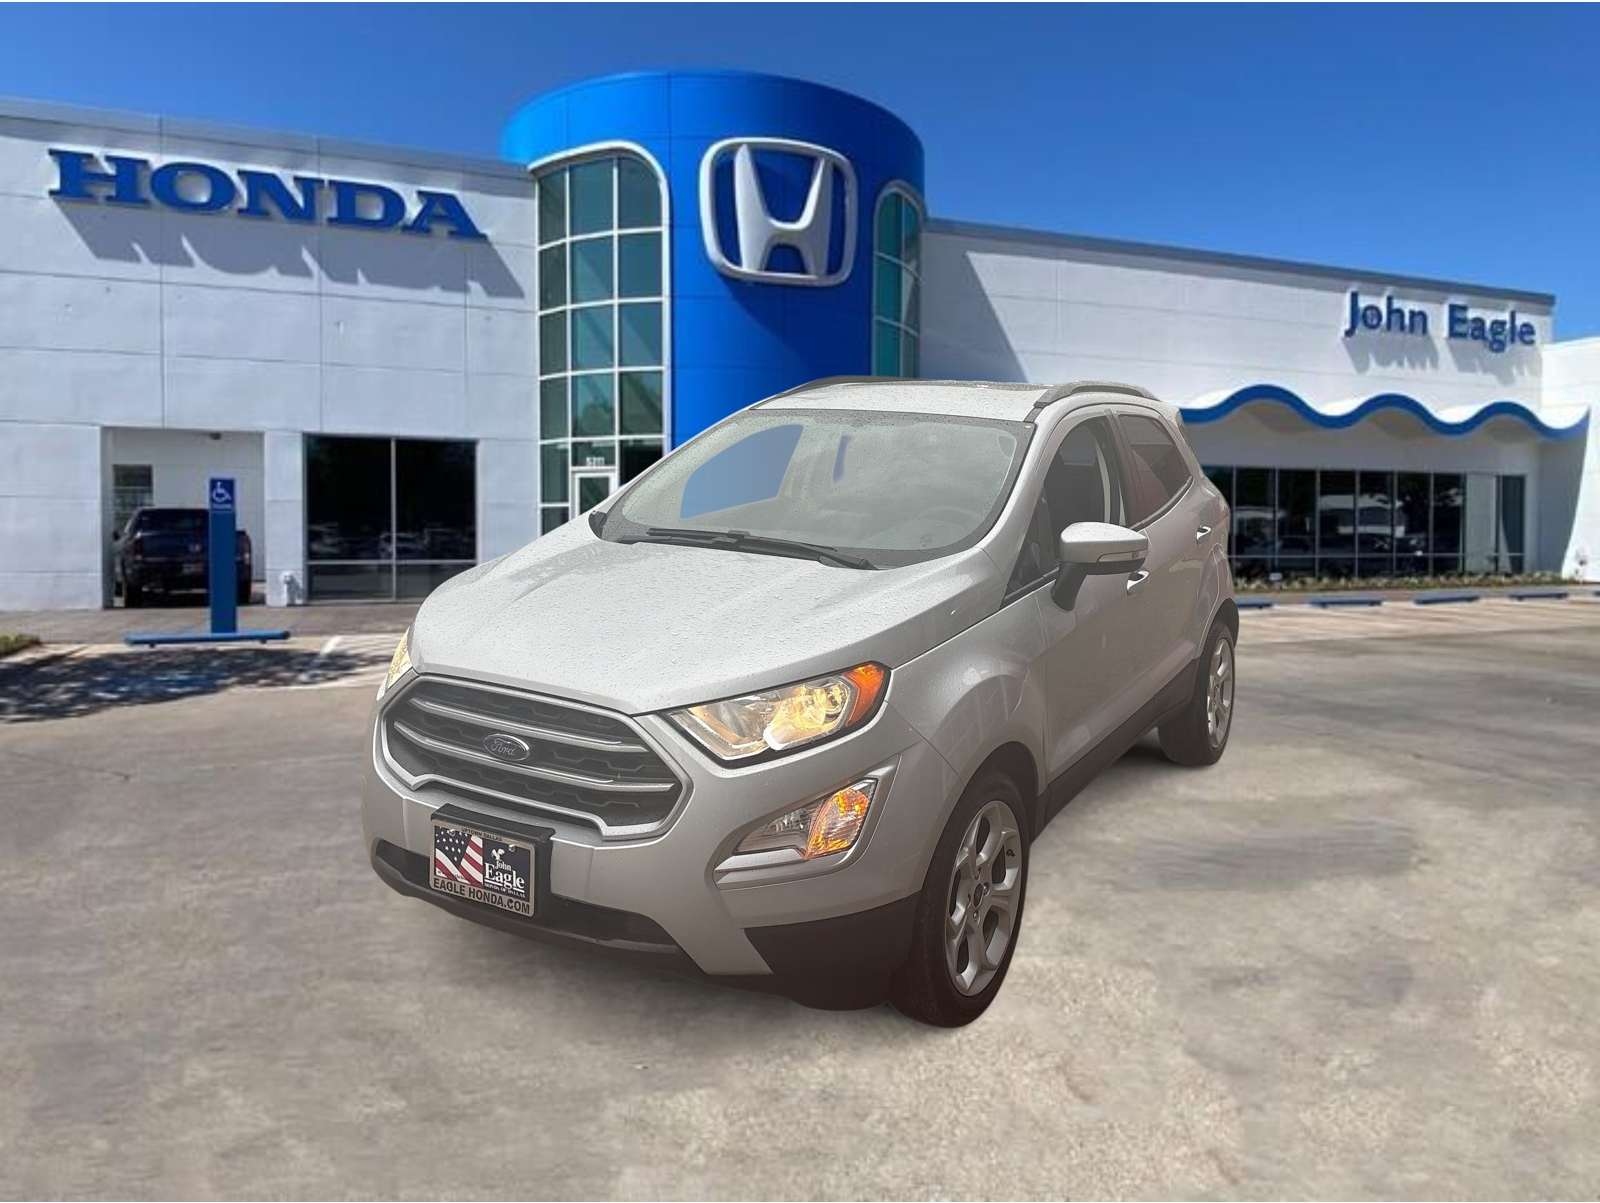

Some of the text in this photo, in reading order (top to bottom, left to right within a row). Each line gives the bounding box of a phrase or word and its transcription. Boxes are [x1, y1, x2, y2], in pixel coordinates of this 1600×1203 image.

[48, 149, 487, 241] HONDA
[1344, 291, 1536, 353] John Eagle
[484, 862, 525, 889] Eagle
[494, 861, 511, 872] John
[433, 878, 465, 896] EAGLE
[468, 886, 530, 914] HONDA.COM
